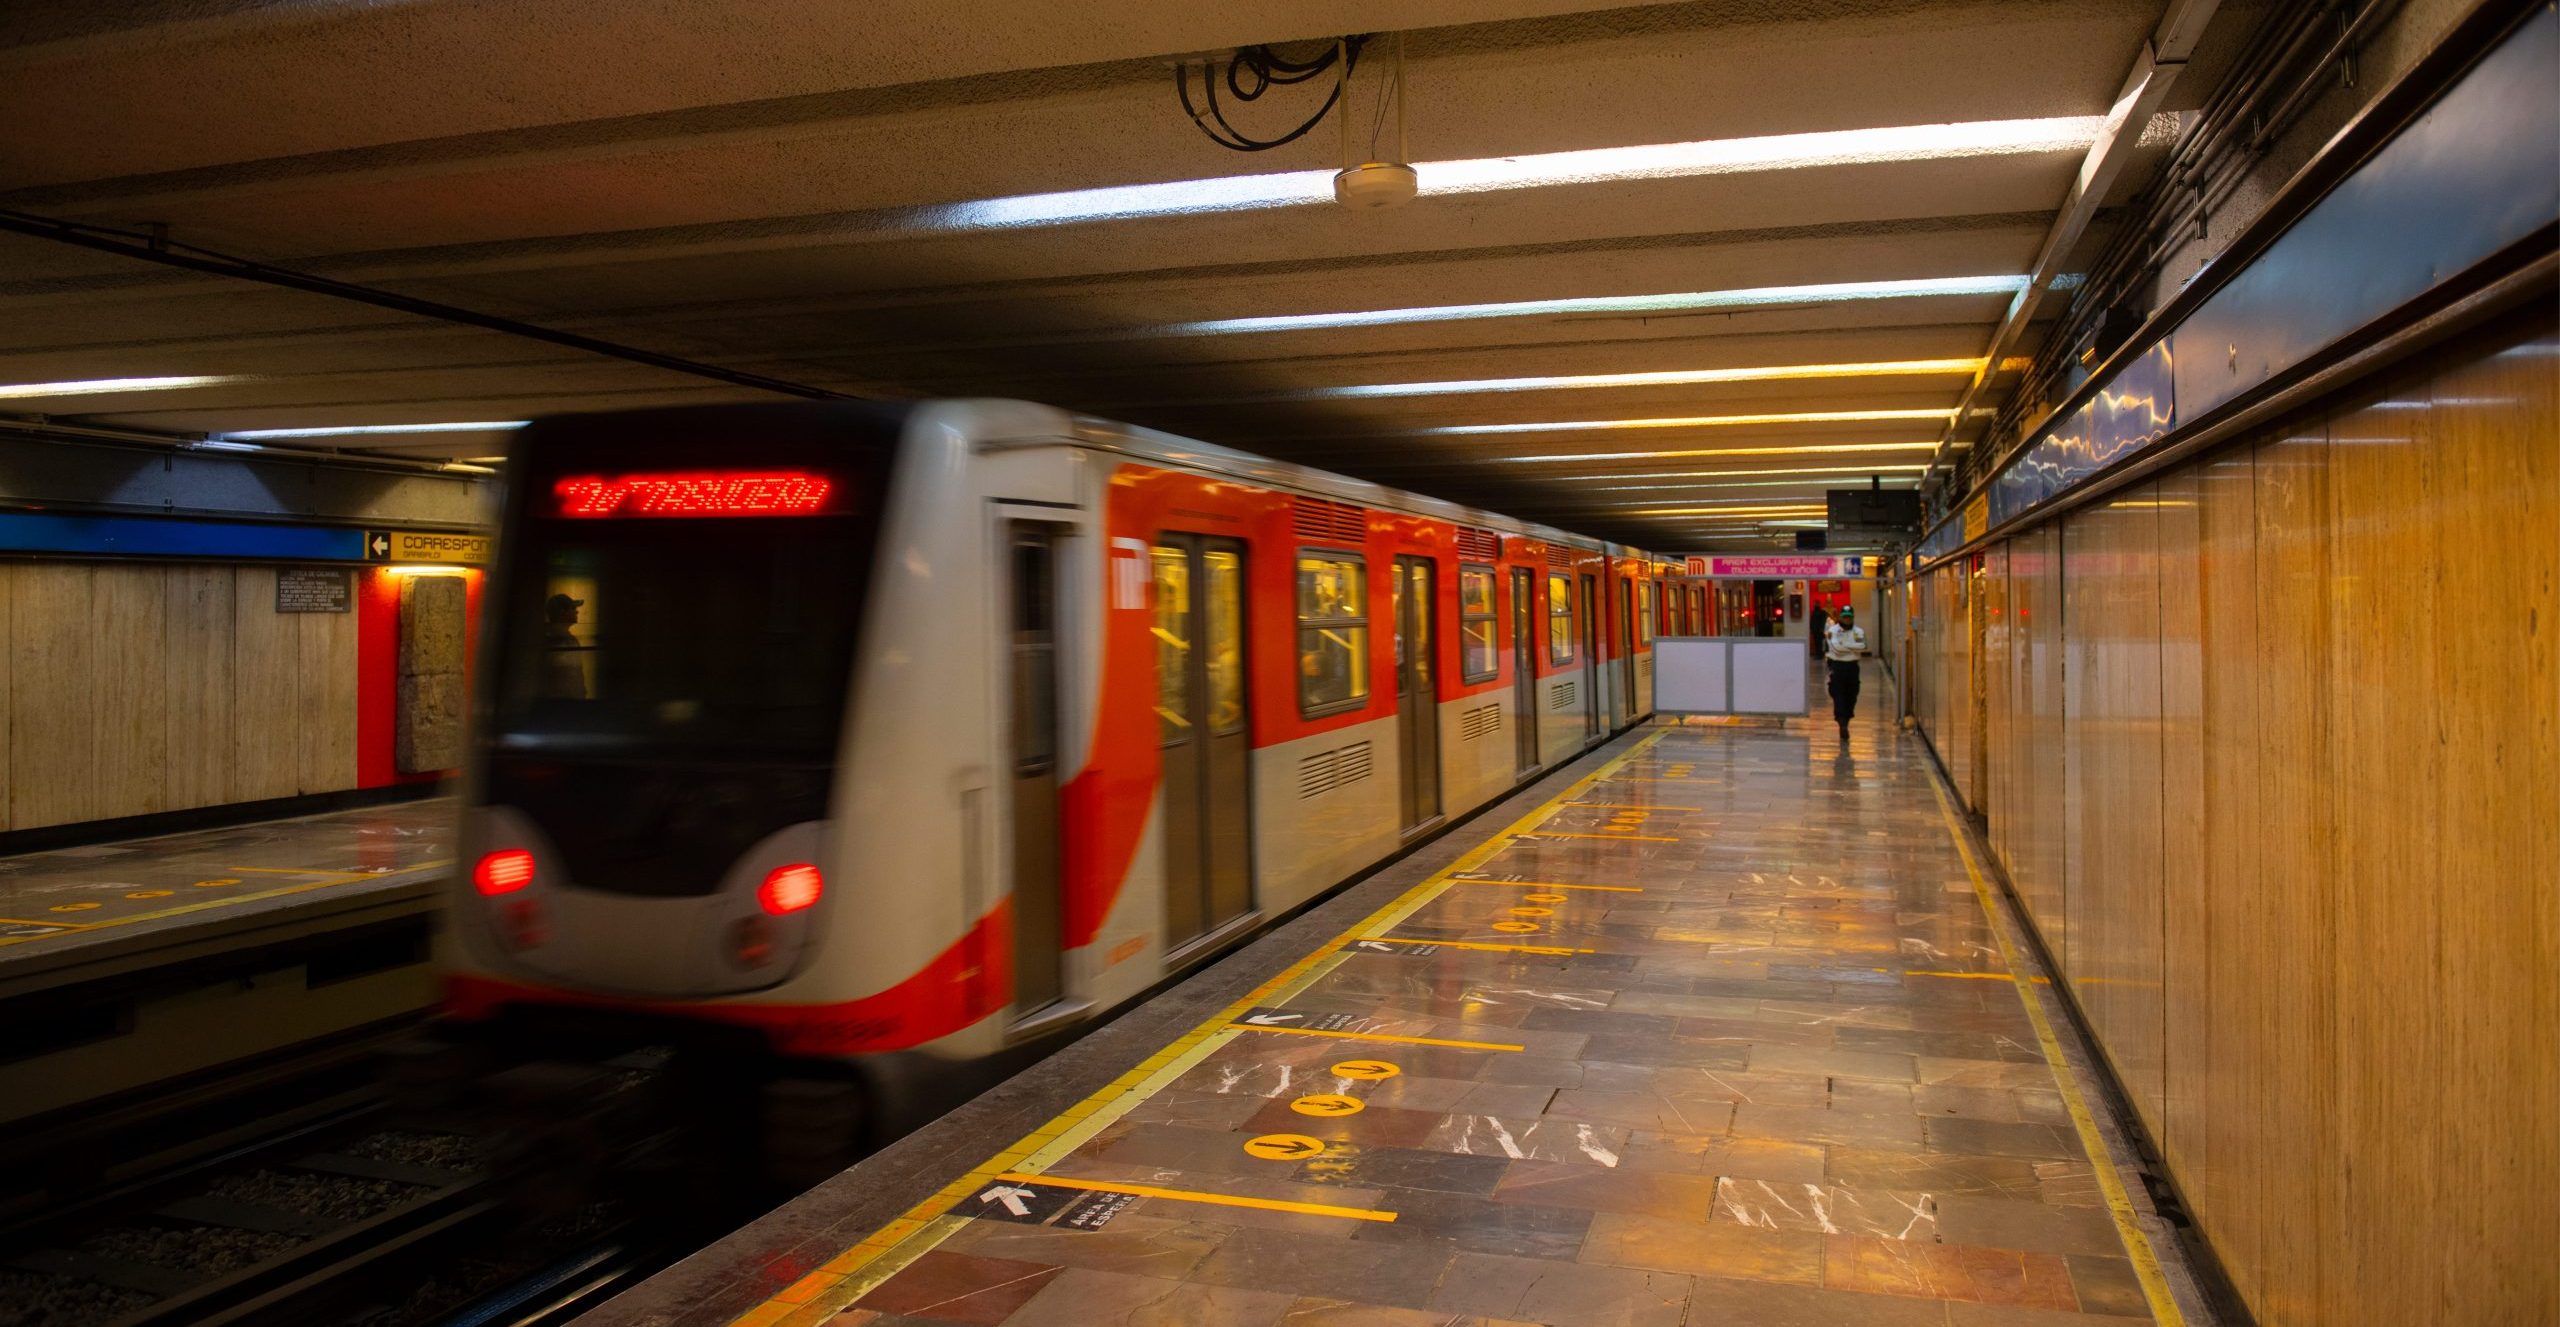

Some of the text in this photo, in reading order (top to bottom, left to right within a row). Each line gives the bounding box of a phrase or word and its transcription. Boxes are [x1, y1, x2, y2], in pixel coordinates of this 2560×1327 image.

[403, 536, 492, 552] CORRESPON
[1791, 566, 1818, 574] NIÑOS
[1090, 1196, 1136, 1227] ESPERA
